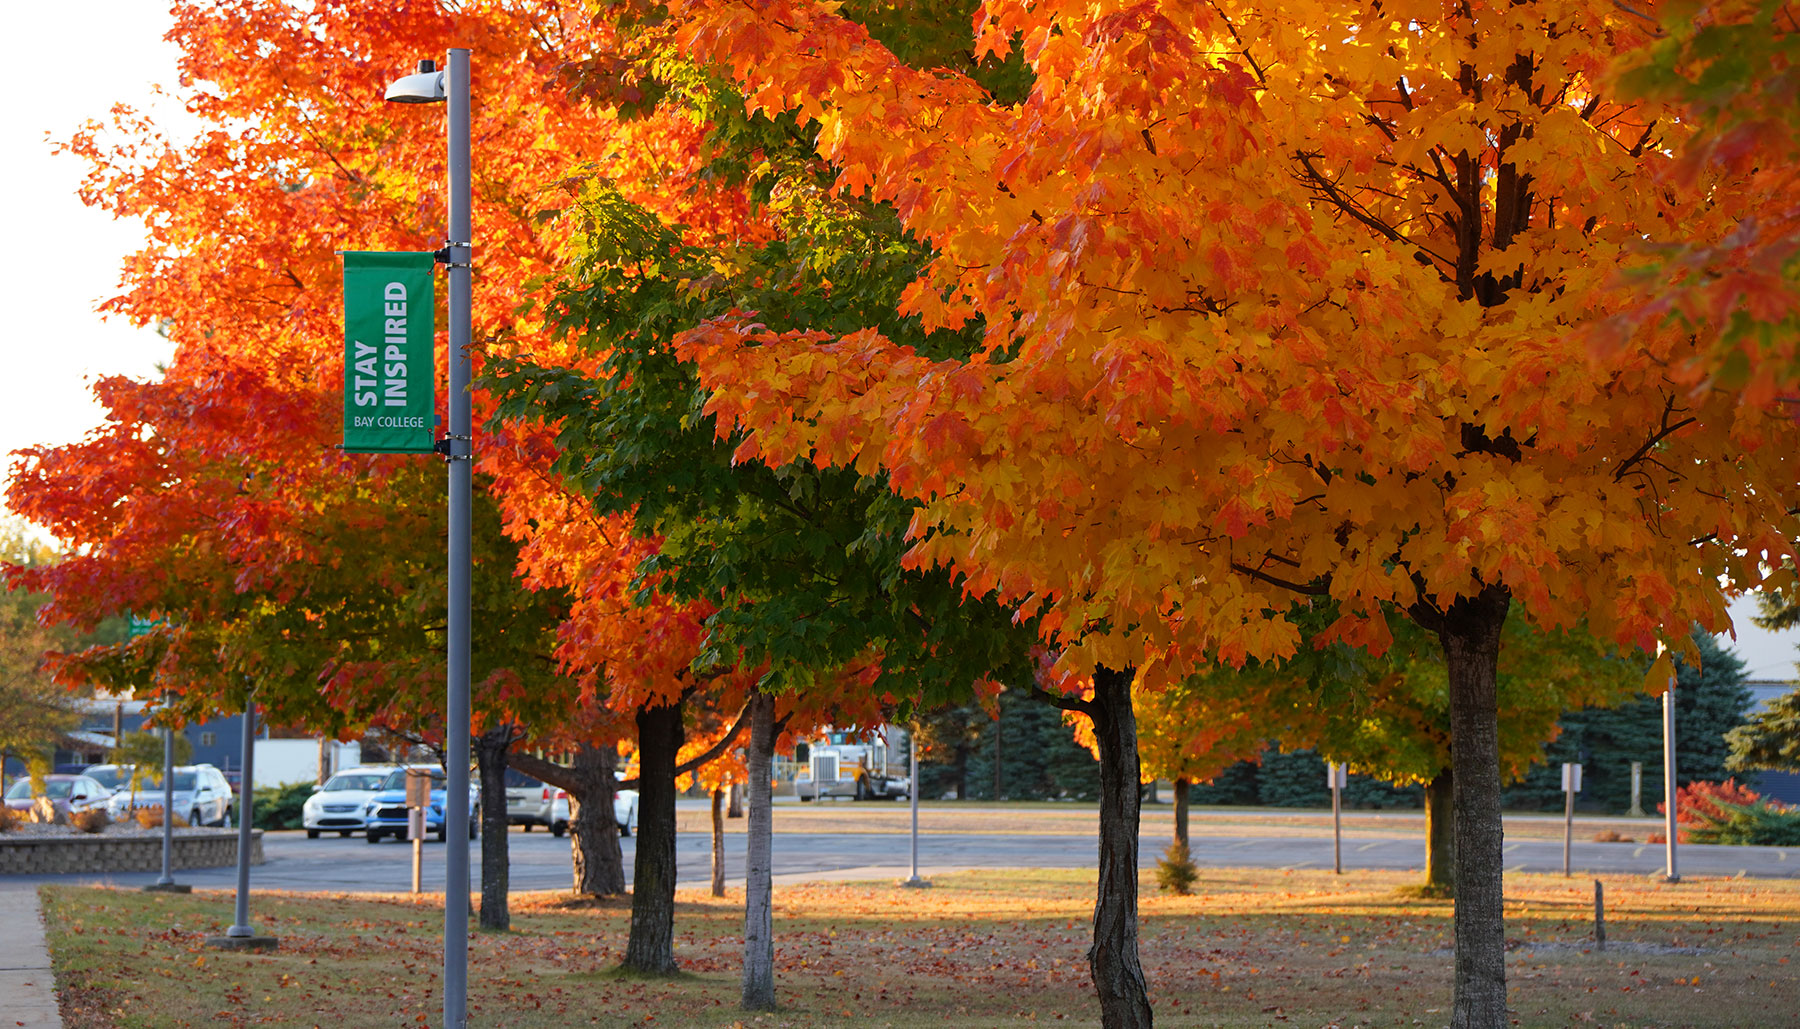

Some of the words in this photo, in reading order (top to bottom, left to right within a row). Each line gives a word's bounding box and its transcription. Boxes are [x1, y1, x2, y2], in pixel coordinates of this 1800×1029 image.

[355, 340, 377, 407] STAY
[384, 282, 407, 407] INSPIRED
[354, 416, 374, 427] BAY
[377, 416, 424, 428] COLLEGE
